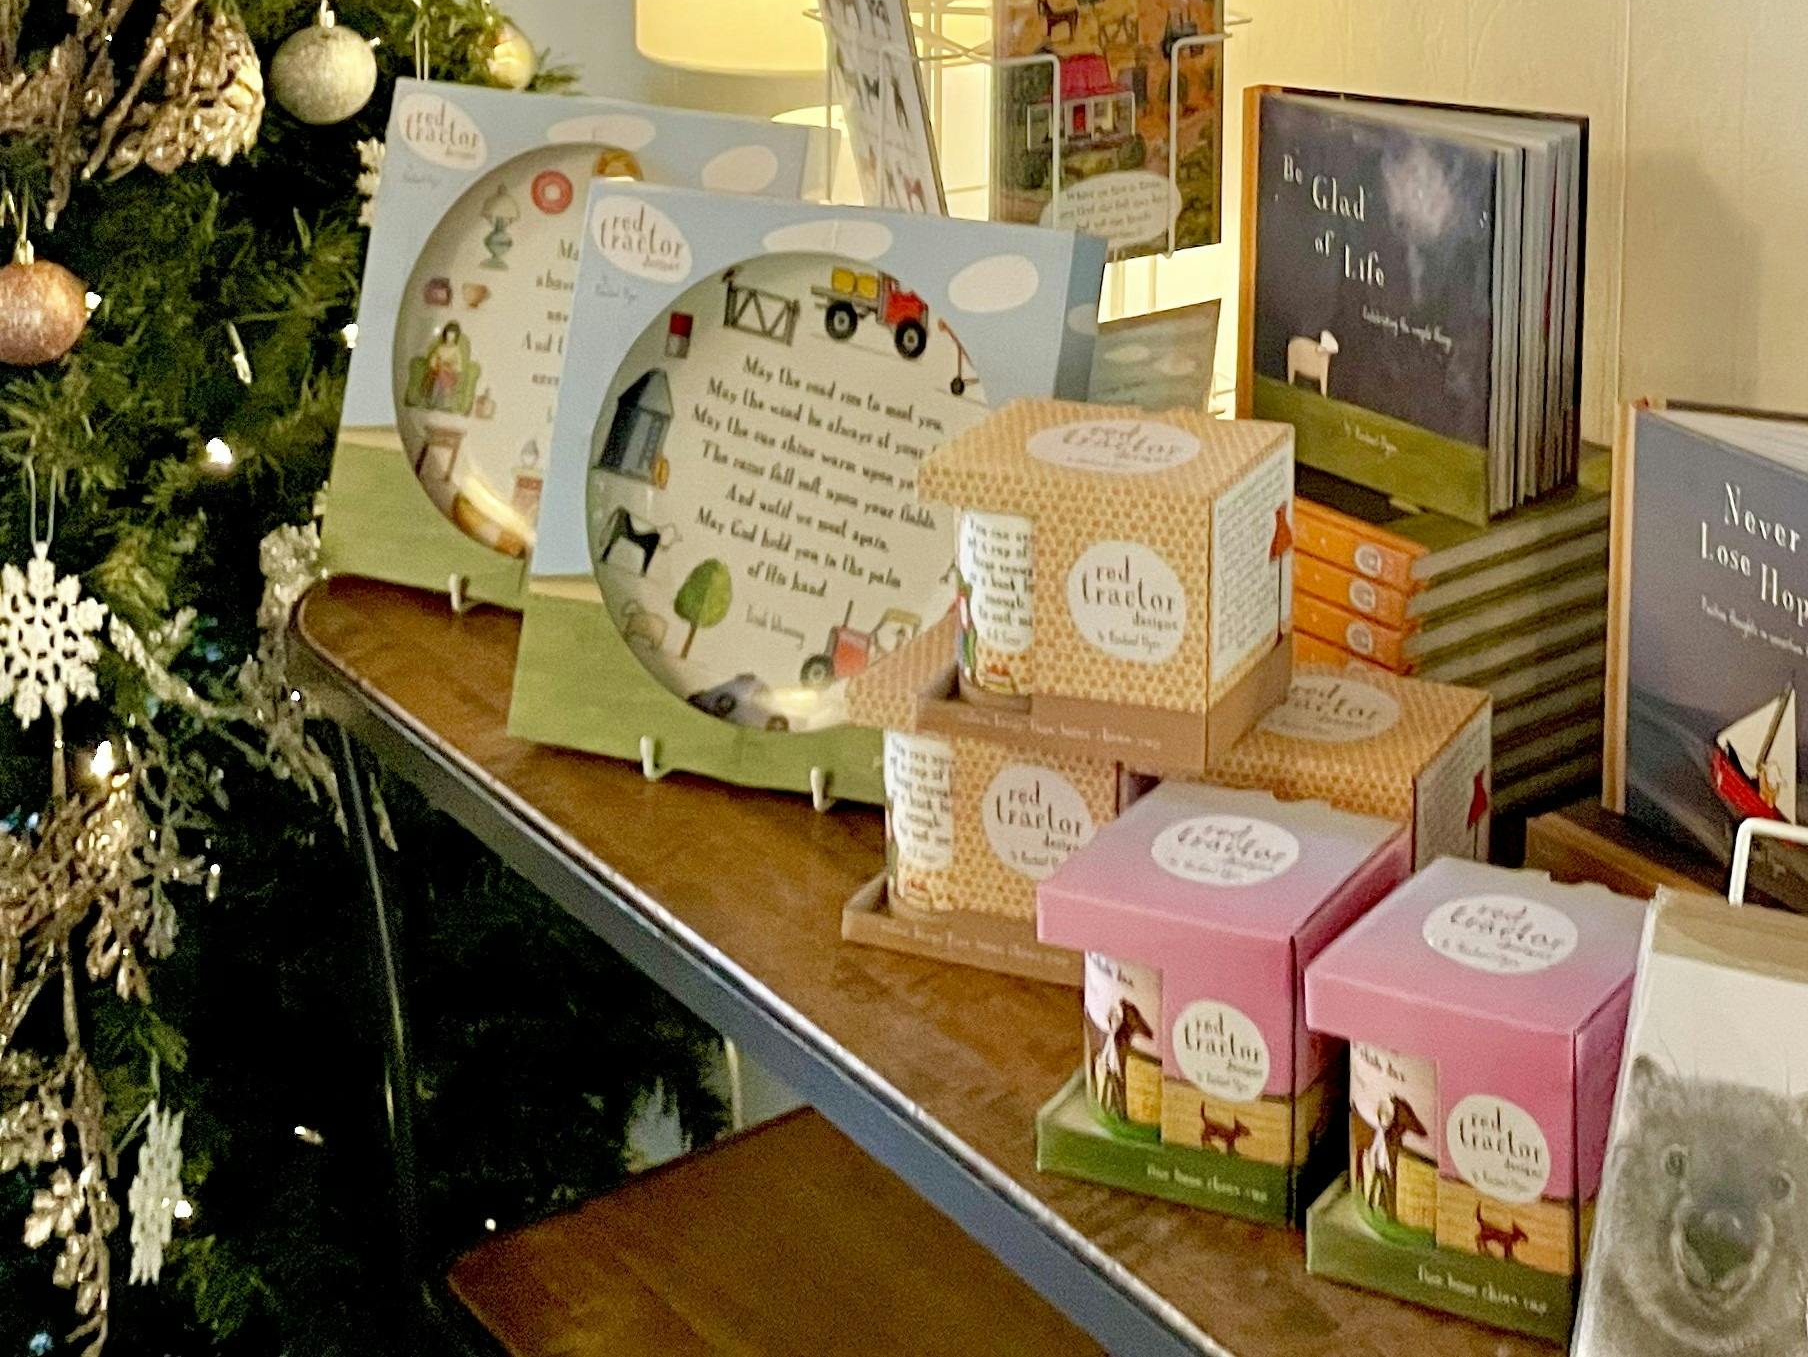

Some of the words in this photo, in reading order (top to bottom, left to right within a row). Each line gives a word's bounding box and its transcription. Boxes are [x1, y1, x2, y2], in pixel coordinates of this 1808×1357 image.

[405, 114, 480, 150] tractor
[416, 103, 446, 128] red
[1283, 154, 1303, 185] Be
[1311, 175, 1366, 223] Glad
[612, 204, 645, 232] red
[600, 216, 685, 259] tractor
[1314, 230, 1335, 258] of
[1344, 243, 1385, 289] Life
[743, 354, 774, 382] May
[779, 367, 801, 389] the
[707, 376, 737, 405] May
[742, 388, 764, 411] the
[692, 404, 721, 432] May
[727, 416, 749, 438] the
[696, 506, 725, 535] May
[1723, 481, 1801, 553] Never
[1701, 520, 1752, 577] Lose
[1096, 555, 1130, 583] red
[1082, 570, 1176, 612] tractor
[1132, 611, 1178, 632] designs
[1009, 780, 1040, 805] red
[996, 795, 1081, 837] tractor
[1205, 824, 1253, 841] red
[1177, 826, 1287, 861] tractor
[1450, 905, 1564, 950] tractor
[1195, 1011, 1225, 1037] red
[1184, 1022, 1260, 1064] tractor
[1470, 1106, 1503, 1132] red
[1459, 1117, 1541, 1164] tractor
